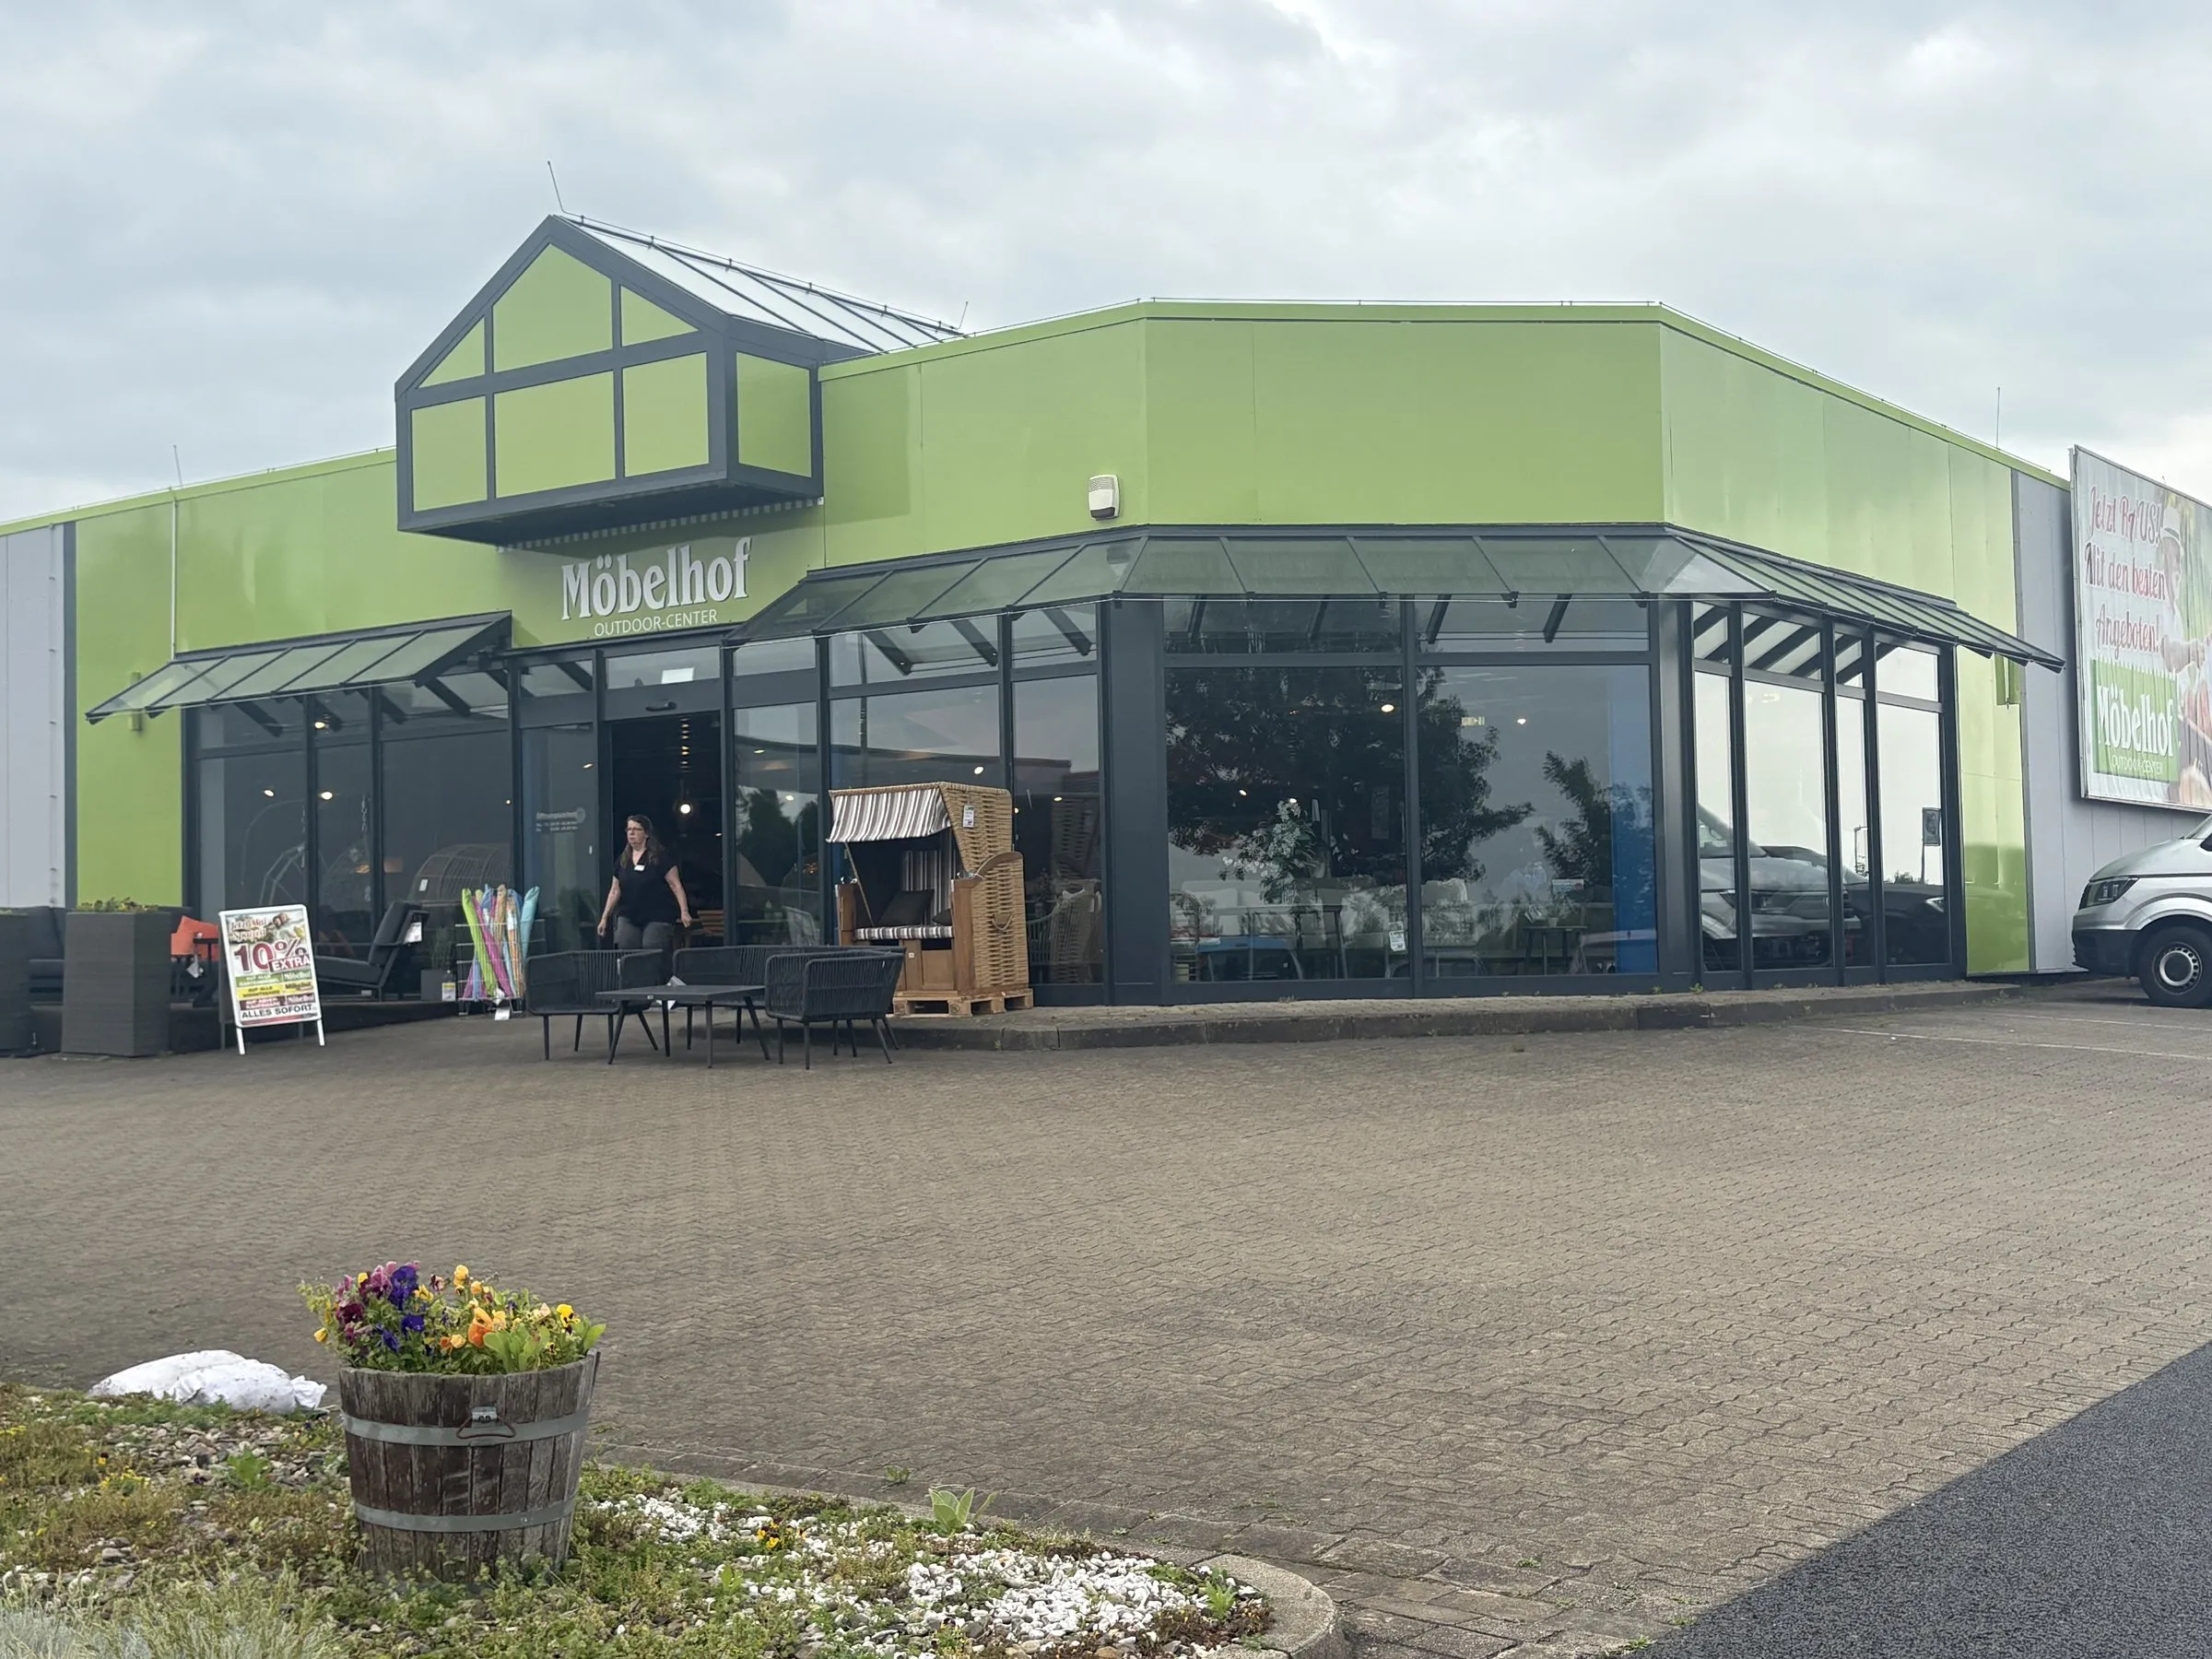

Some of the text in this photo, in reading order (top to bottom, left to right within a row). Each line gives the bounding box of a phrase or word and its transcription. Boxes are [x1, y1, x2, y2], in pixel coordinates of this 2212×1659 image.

[561, 536, 752, 620] Möbelhof
[2109, 552, 2129, 594] den
[2133, 558, 2165, 600] besten
[594, 609, 717, 637] OUTDOOR-CENTER
[2096, 603, 2159, 660] Angeboten!
[2097, 682, 2174, 757] Möbelhof
[233, 937, 307, 971] 10%
[272, 956, 311, 971] EXTRA
[242, 1009, 272, 1018] ALLES
[275, 1004, 312, 1014] SOFORT
